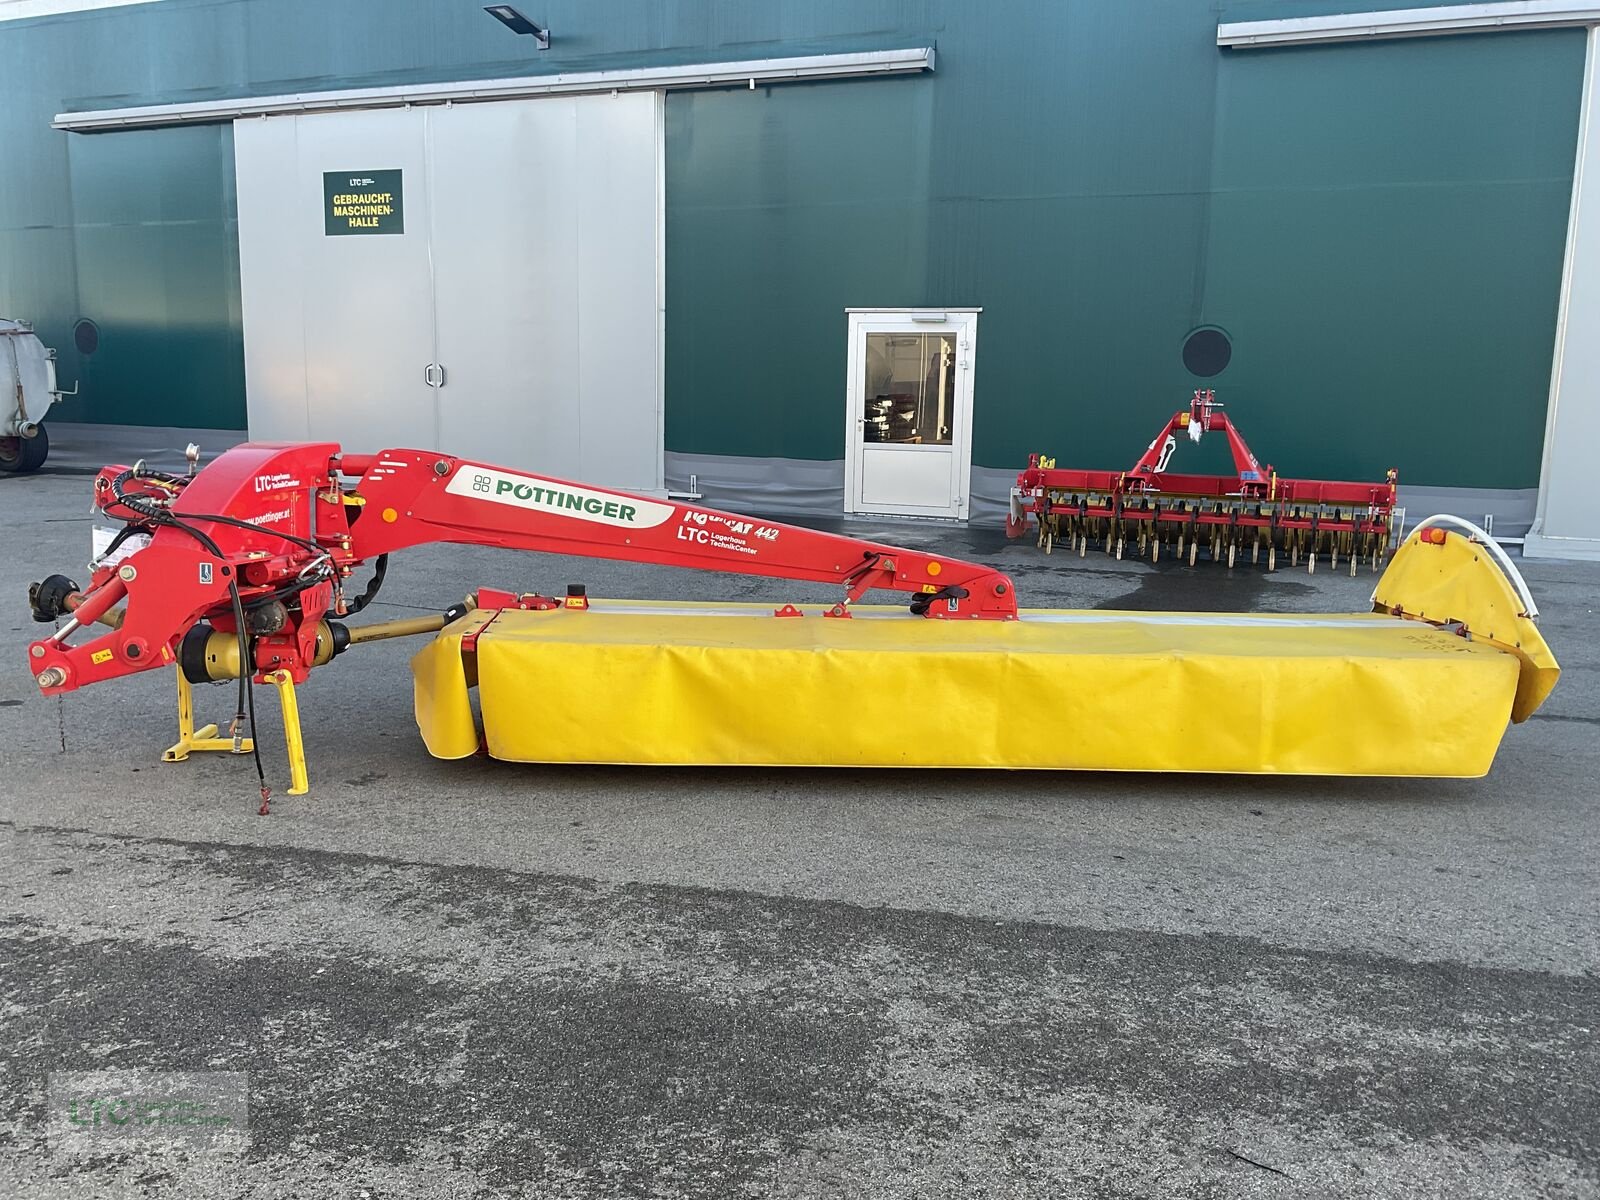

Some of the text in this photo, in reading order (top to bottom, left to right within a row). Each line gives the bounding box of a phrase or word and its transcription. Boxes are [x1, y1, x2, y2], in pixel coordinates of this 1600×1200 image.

[349, 178, 361, 186] LTC
[333, 193, 394, 205] GEBRAUCHT-
[333, 205, 394, 216] MASCHINEN-
[348, 217, 379, 227] HALLE
[255, 475, 271, 492] LTC
[495, 479, 636, 522] PÖTTINGER
[677, 525, 709, 544] LTC
[710, 532, 746, 545] Lagerhaus
[754, 527, 780, 541] 442
[709, 539, 758, 555] TechnikCenter
